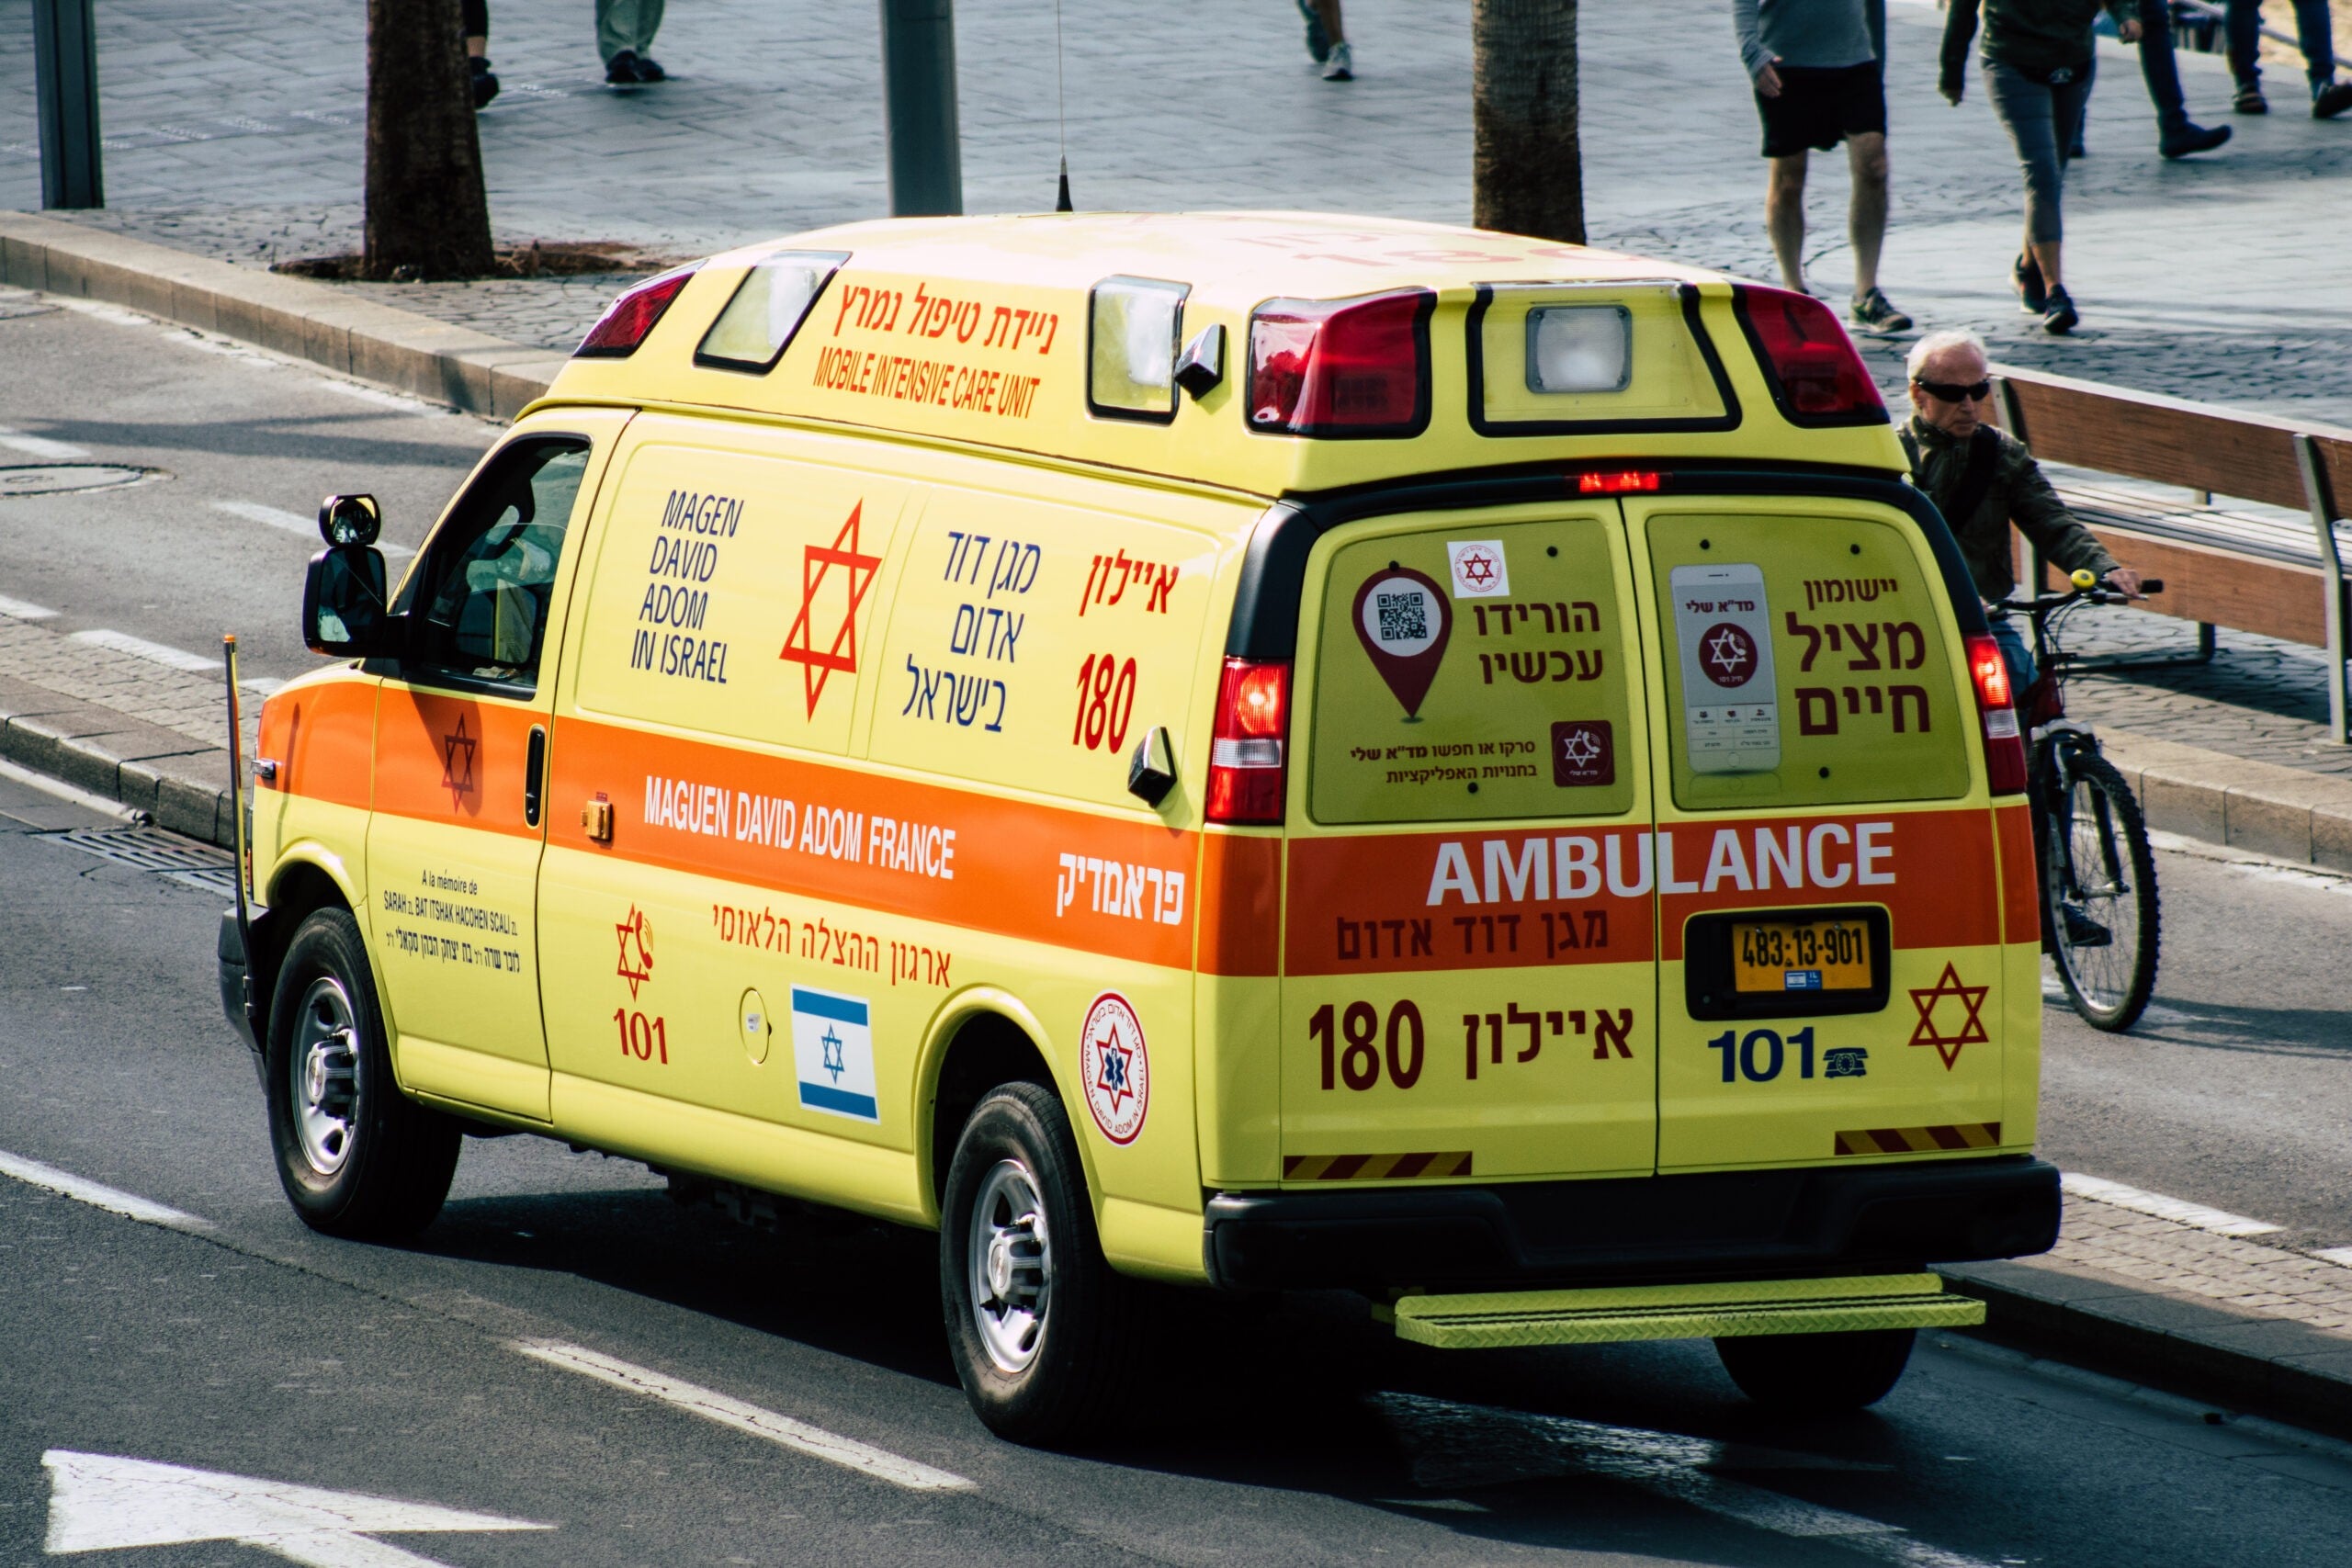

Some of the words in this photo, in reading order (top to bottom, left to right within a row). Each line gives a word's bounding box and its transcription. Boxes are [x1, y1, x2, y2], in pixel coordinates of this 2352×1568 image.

[833, 284, 903, 337] נמרץ
[907, 282, 981, 344] טיפול
[983, 306, 1059, 355] ניידת
[813, 345, 876, 394] MOBILE
[871, 355, 955, 406] INTENSIVE
[952, 366, 1001, 413] CARE
[997, 373, 1041, 420] UNIT
[661, 489, 744, 537] MAGEN
[649, 536, 718, 583] DAVID
[944, 531, 991, 585] דוד
[987, 539, 1041, 600] מגן
[1079, 548, 1180, 617] איילון
[639, 582, 709, 631] ADOM
[1472, 601, 1600, 636] הורידו
[1685, 600, 1714, 614] שלי
[1803, 578, 1898, 611] יישומון
[630, 628, 657, 671] IN
[660, 634, 728, 684] ISRAEL
[950, 604, 1024, 663] אדום
[1785, 611, 1926, 672] מציל
[1478, 649, 1603, 684] עכשיו
[902, 653, 1006, 733] בישראל
[1072, 653, 1136, 754] 180
[1794, 684, 1931, 736] חיים
[1350, 746, 1382, 761] שלי
[1431, 743, 1474, 758] חפשו
[1478, 742, 1496, 755] או
[1482, 763, 1538, 779] בחנויות
[1498, 740, 1536, 758] סרקו
[1385, 765, 1478, 785] האפליקציות
[644, 774, 730, 838] MAGUEN
[735, 792, 797, 850] DAVID
[799, 804, 863, 863] ADOM
[868, 816, 956, 880] FRANCE
[429, 870, 435, 887] la
[436, 869, 467, 894] mémoire
[469, 880, 478, 896] de
[1057, 852, 1185, 926] פראמדיק
[1426, 821, 1895, 907] AMBULANCE
[383, 889, 407, 914] SARAH
[415, 897, 428, 919] BAT
[429, 898, 454, 922] ITSHAK
[456, 904, 489, 931] HACOHEN
[490, 911, 511, 935] SCALI
[712, 903, 791, 954] הלאומי
[1453, 913, 1521, 954] דוד
[1541, 909, 1608, 959] מגן
[801, 918, 878, 974] ההצלה
[1337, 916, 1433, 961] אדום
[889, 940, 951, 988] ארגון
[613, 1007, 668, 1066] 101
[1309, 998, 1424, 1091] 180
[1463, 1002, 1634, 1079] איילון
[1708, 1026, 1815, 1083] 101
[1093, 1100, 1113, 1130] DAVID
[1114, 1118, 1133, 1134] ADOM
